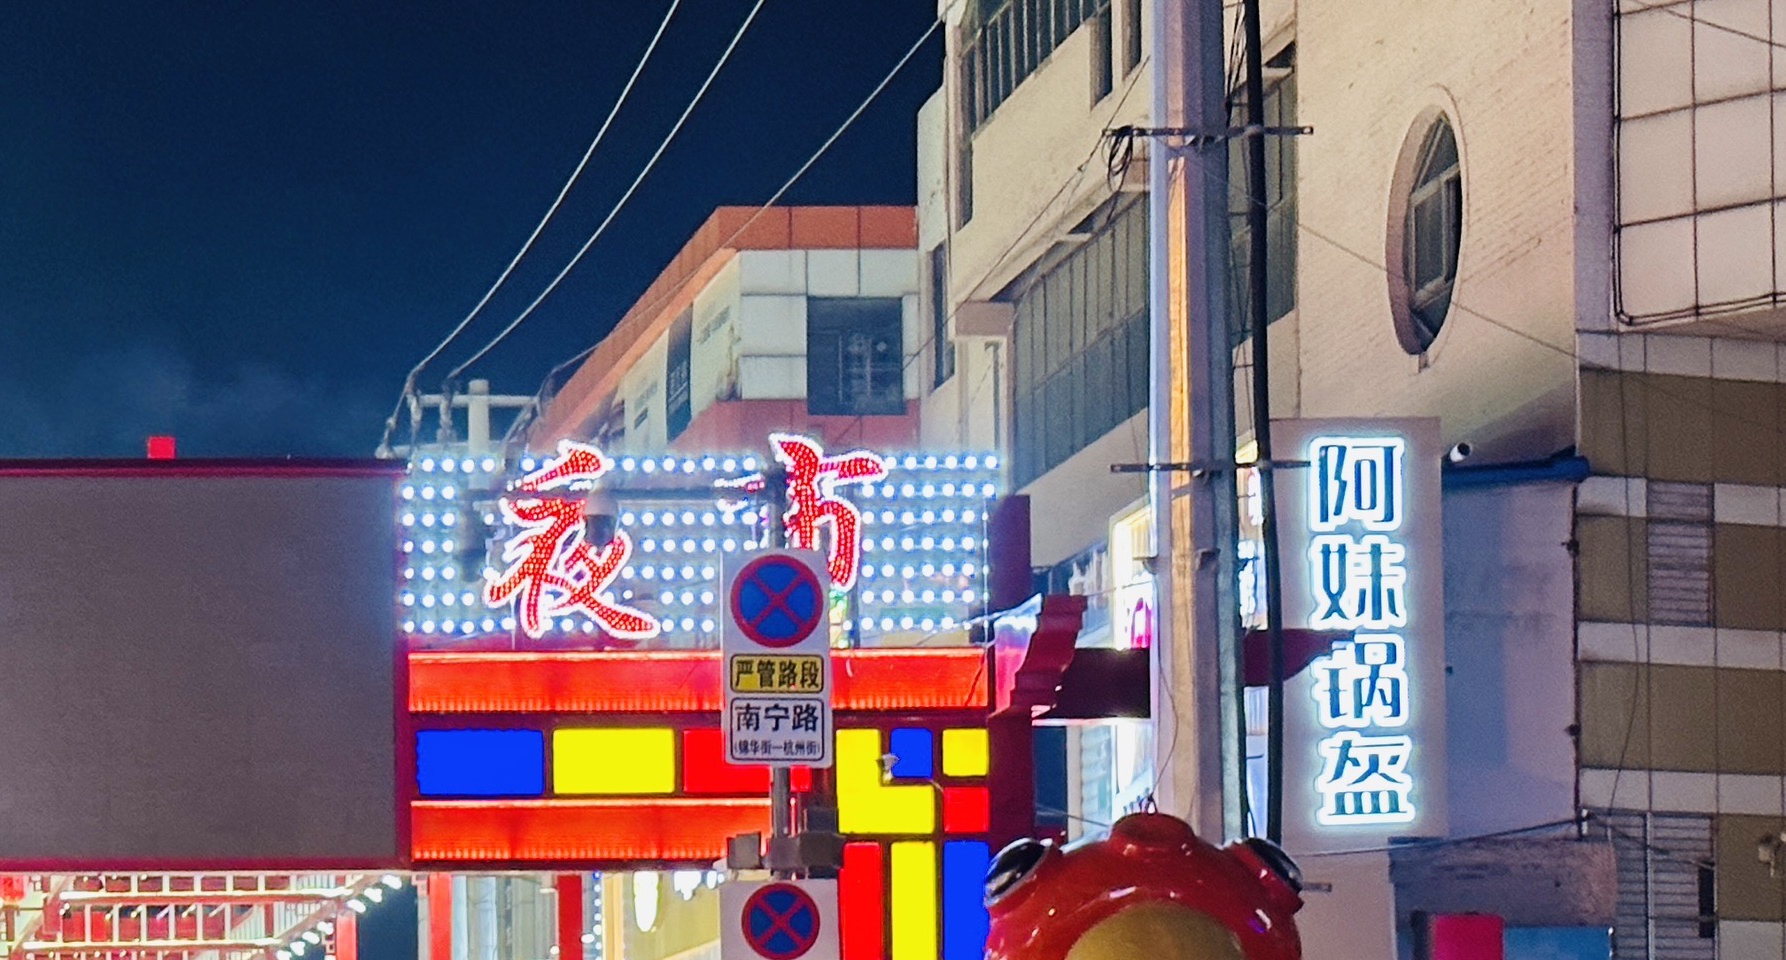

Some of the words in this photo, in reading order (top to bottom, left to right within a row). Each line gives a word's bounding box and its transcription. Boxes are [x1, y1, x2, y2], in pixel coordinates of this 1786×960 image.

[1310, 436, 1415, 826] 阿妹锅盔
[735, 659, 820, 688] 严管路段
[735, 703, 819, 732] 南宁路
